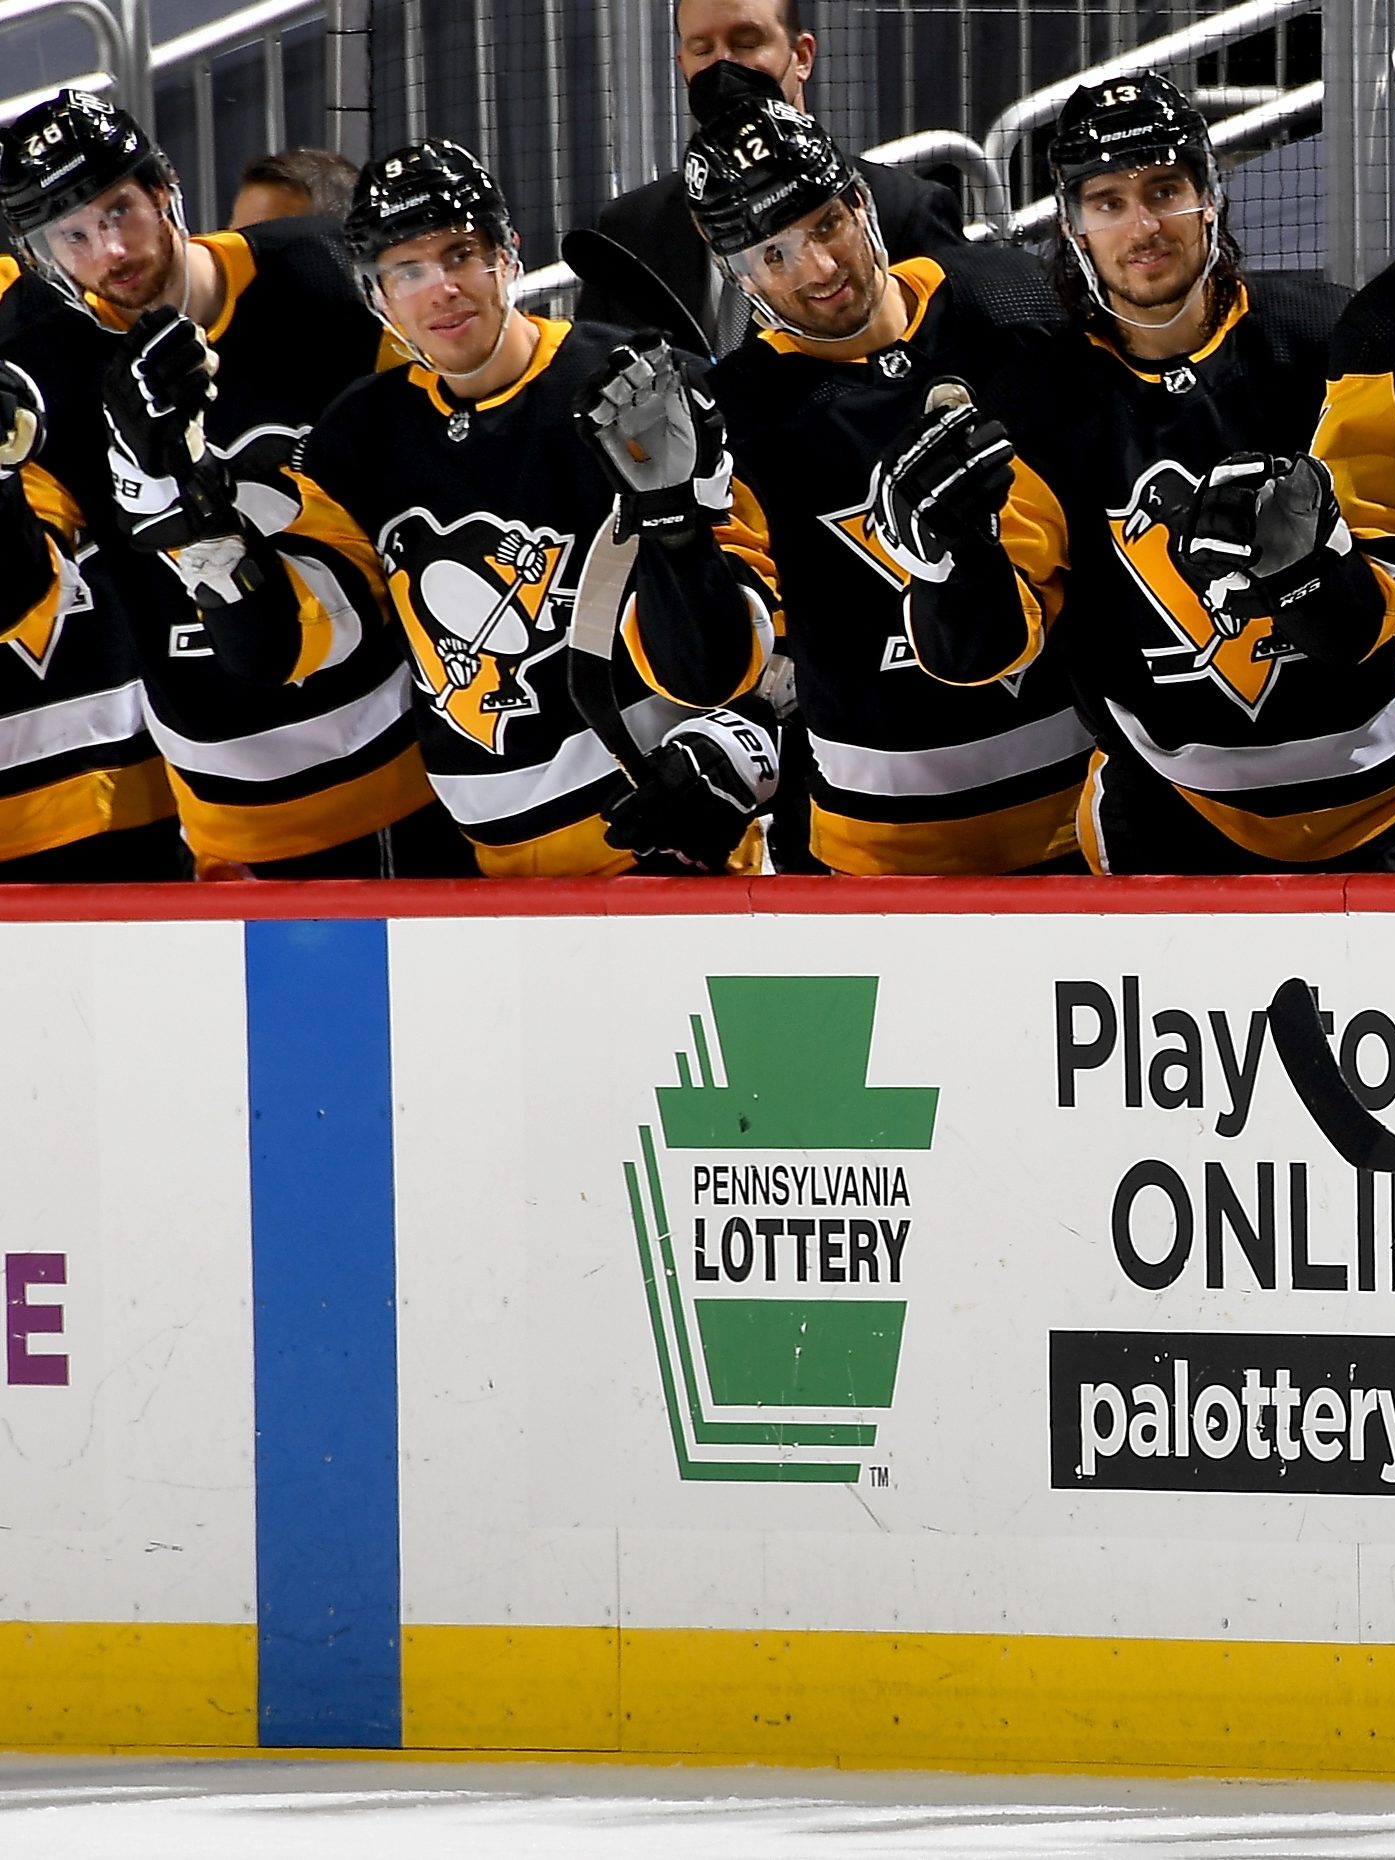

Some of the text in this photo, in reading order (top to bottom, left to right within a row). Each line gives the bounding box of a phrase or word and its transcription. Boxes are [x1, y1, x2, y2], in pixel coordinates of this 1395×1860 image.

[1103, 85, 1137, 107] 13
[1100, 124, 1153, 144] BAUER
[732, 137, 770, 170] 12
[752, 170, 799, 205] BAUER
[1055, 974, 1268, 1137] Play
[693, 1164, 911, 1207] PENNSYLVANIA
[694, 1216, 912, 1283] LOTTERY
[5, 1252, 69, 1386] E
[868, 1465, 889, 1487] TM
